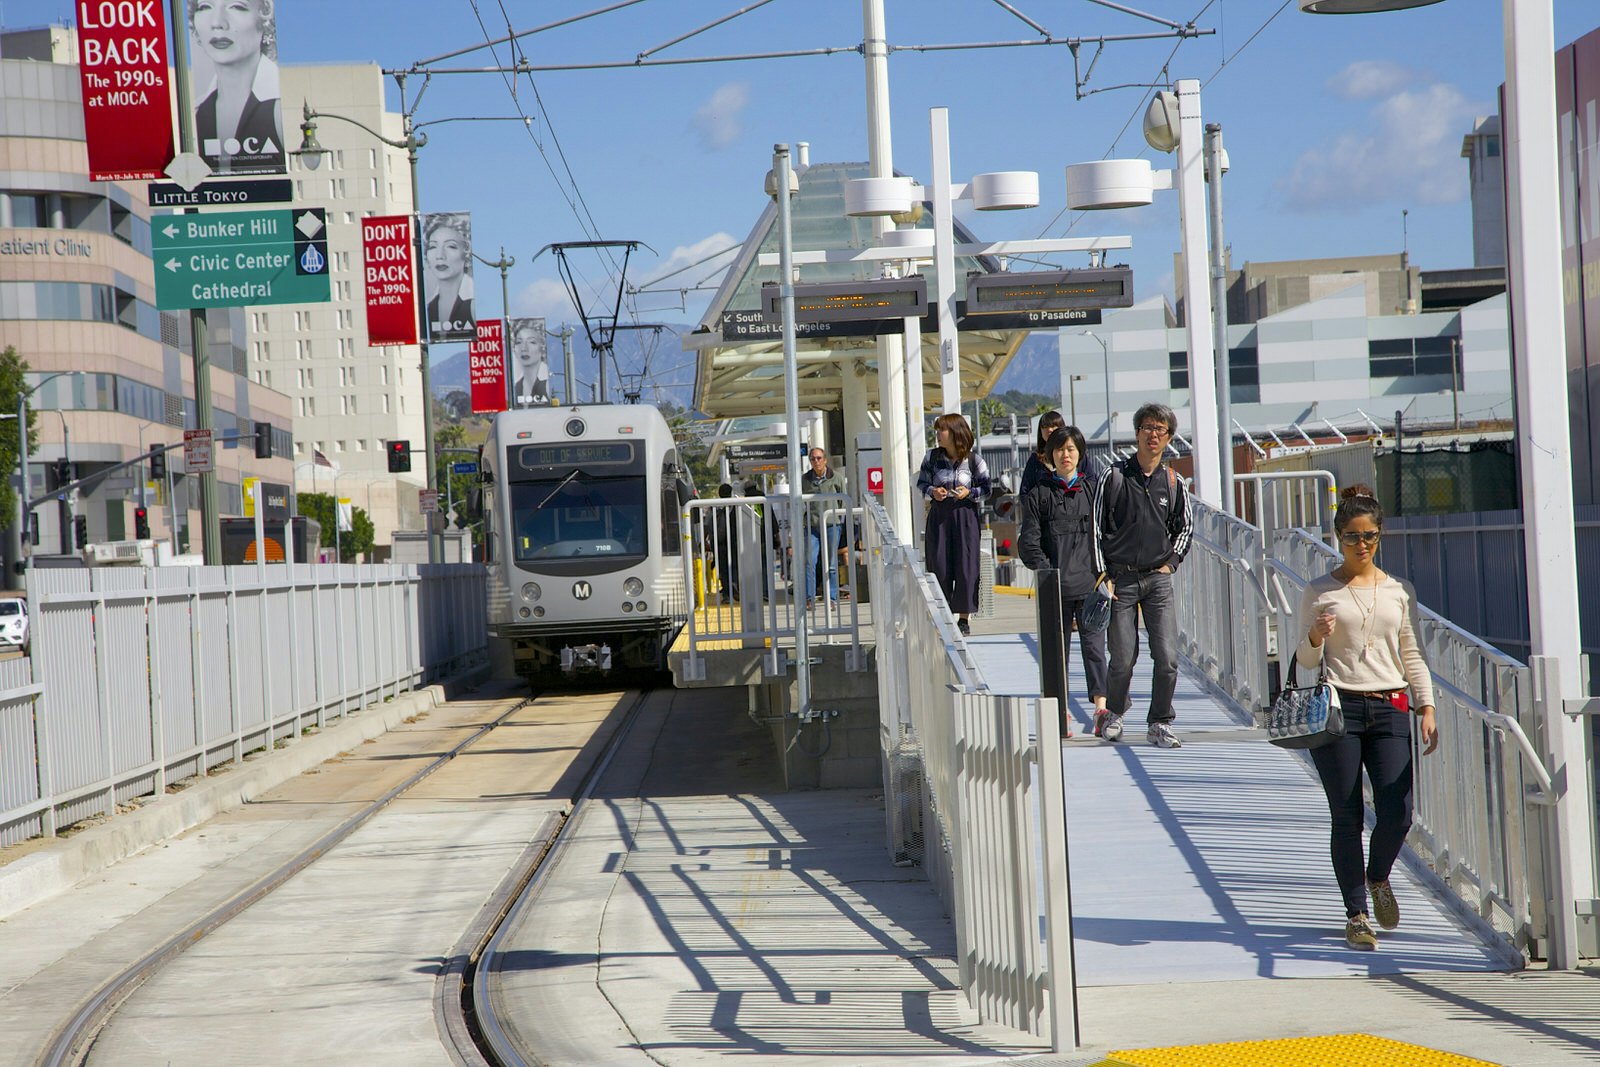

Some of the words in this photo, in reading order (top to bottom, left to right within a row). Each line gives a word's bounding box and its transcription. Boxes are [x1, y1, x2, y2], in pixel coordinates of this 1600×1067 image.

[81, 1, 157, 29] LOOK
[84, 37, 161, 66] BACK
[85, 73, 110, 87] The
[114, 70, 163, 87] 1990s
[88, 94, 104, 107] at
[107, 91, 149, 106] MOCA
[154, 192, 199, 204] LITTLE
[204, 191, 248, 202] TOKYO
[187, 221, 245, 238] Bunker
[250, 219, 277, 235] Hill
[364, 224, 408, 242] DON'T
[0, 238, 50, 256] atient
[54, 238, 92, 258] Clinic
[365, 244, 408, 262] LOOK
[190, 255, 230, 272] Civic
[235, 252, 291, 270] Center
[367, 265, 409, 283] BACK
[191, 280, 272, 300] Cathedral
[367, 286, 381, 295] The
[383, 283, 410, 295] 1990s
[368, 298, 377, 306] at
[379, 295, 402, 305] MOCA
[1029, 312, 1039, 321] to
[1041, 310, 1087, 320] Pasadena
[477, 325, 501, 338] ON'T
[737, 325, 747, 334] to
[749, 324, 770, 333] East
[772, 324, 784, 333] Lo
[794, 323, 831, 333] Angeles
[470, 341, 500, 353] LOOK
[471, 356, 502, 368] BACK
[540, 450, 555, 464] OUT
[560, 448, 571, 462] OF
[576, 447, 612, 461] SERVICE
[575, 584, 590, 597] M
